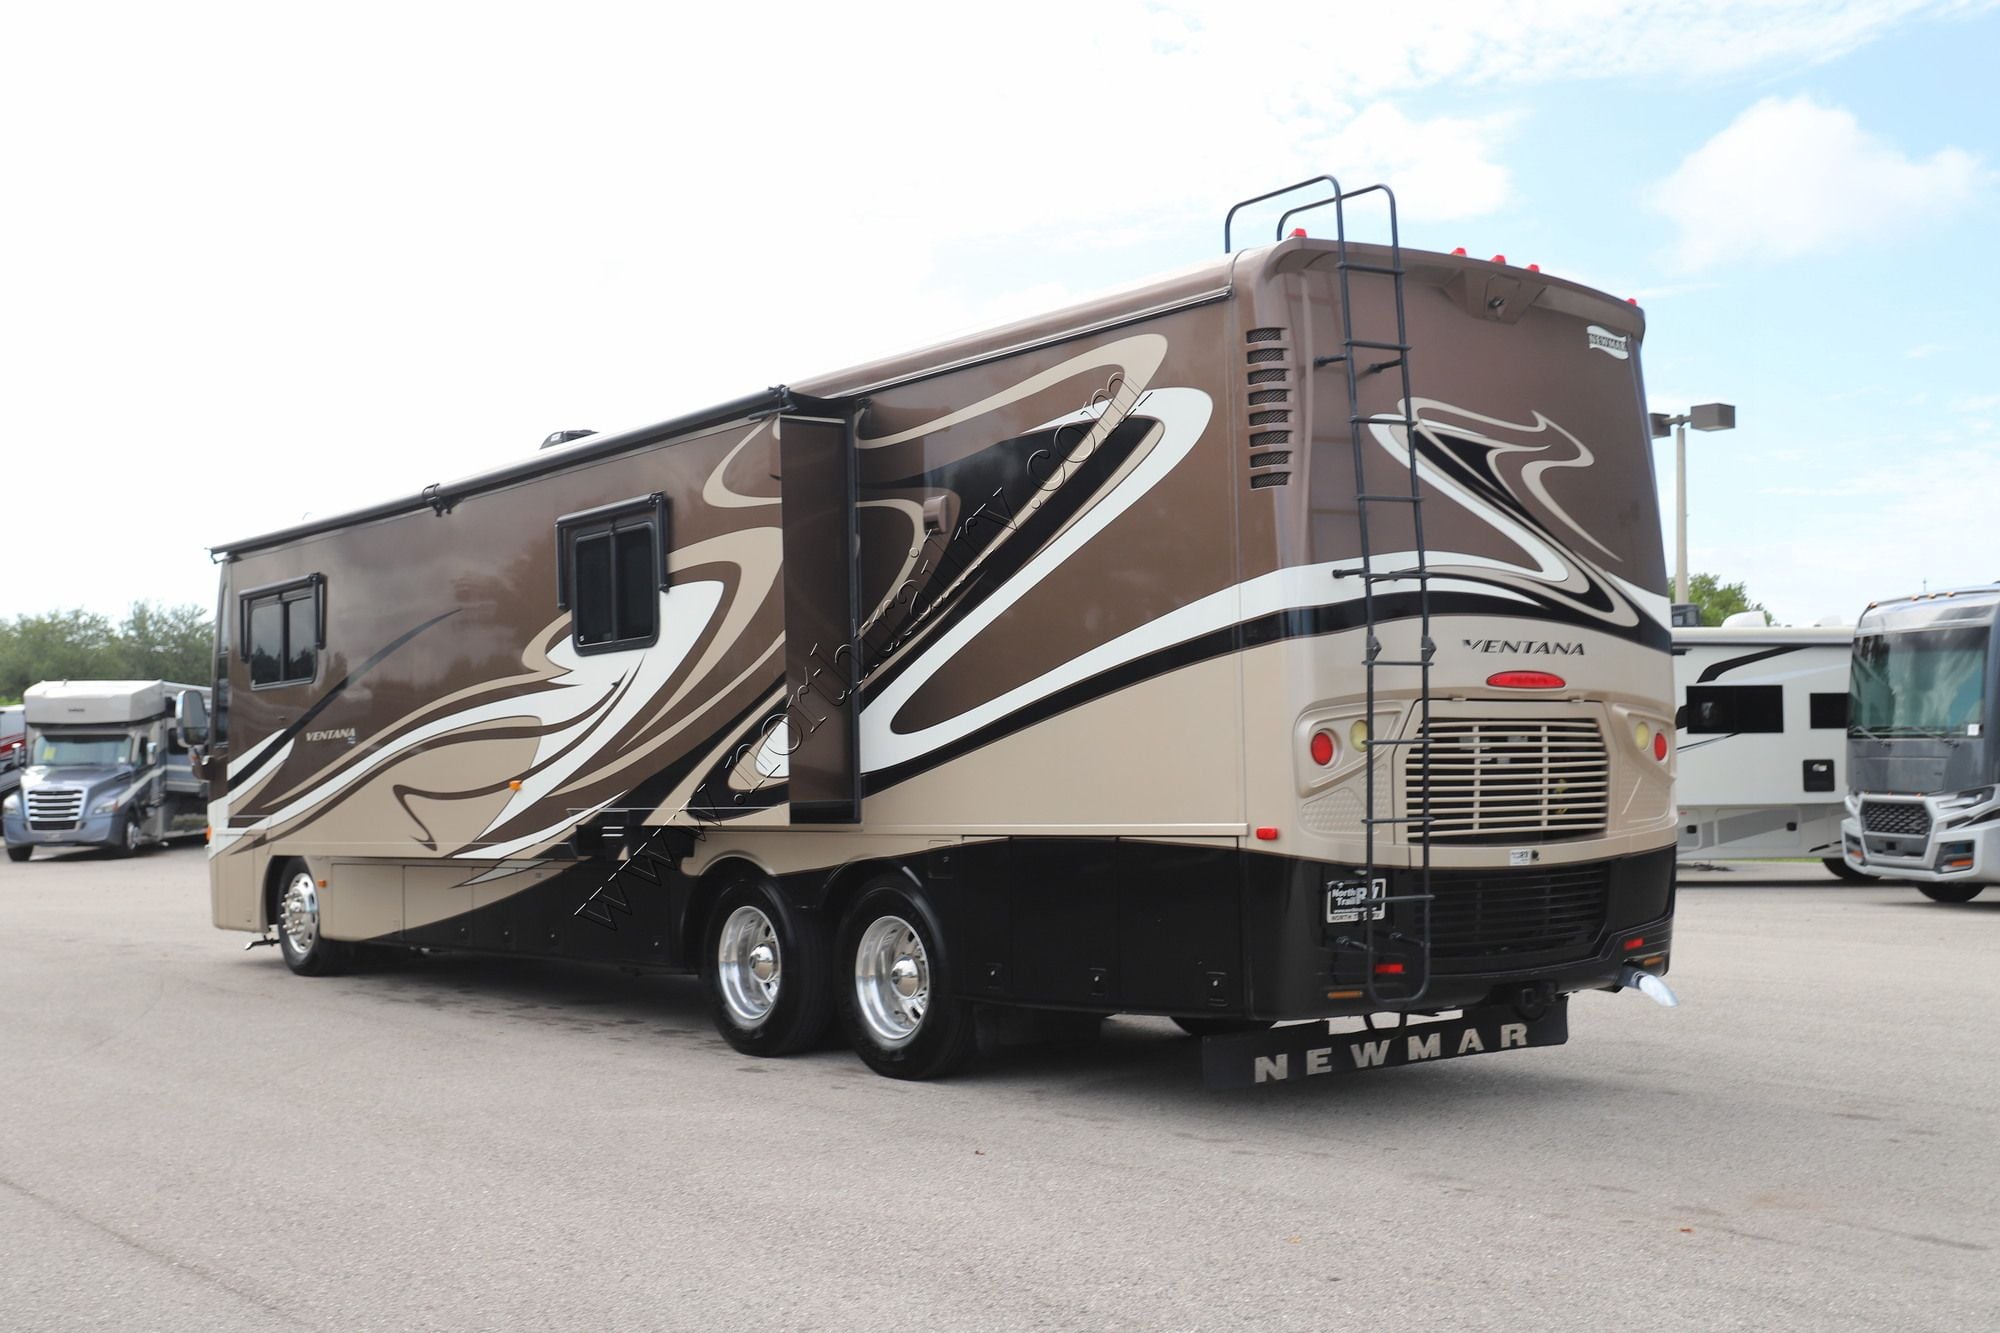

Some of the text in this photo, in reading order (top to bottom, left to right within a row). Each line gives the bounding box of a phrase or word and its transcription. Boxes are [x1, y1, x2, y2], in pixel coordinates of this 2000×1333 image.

[1588, 334, 1627, 352] NEWMAR
[1462, 639, 1585, 656] VENTANA
[305, 728, 356, 742] VENTANA
[1332, 888, 1356, 898] North
[1336, 898, 1356, 906] Trail
[1254, 1022, 1528, 1084] NEWMAR
